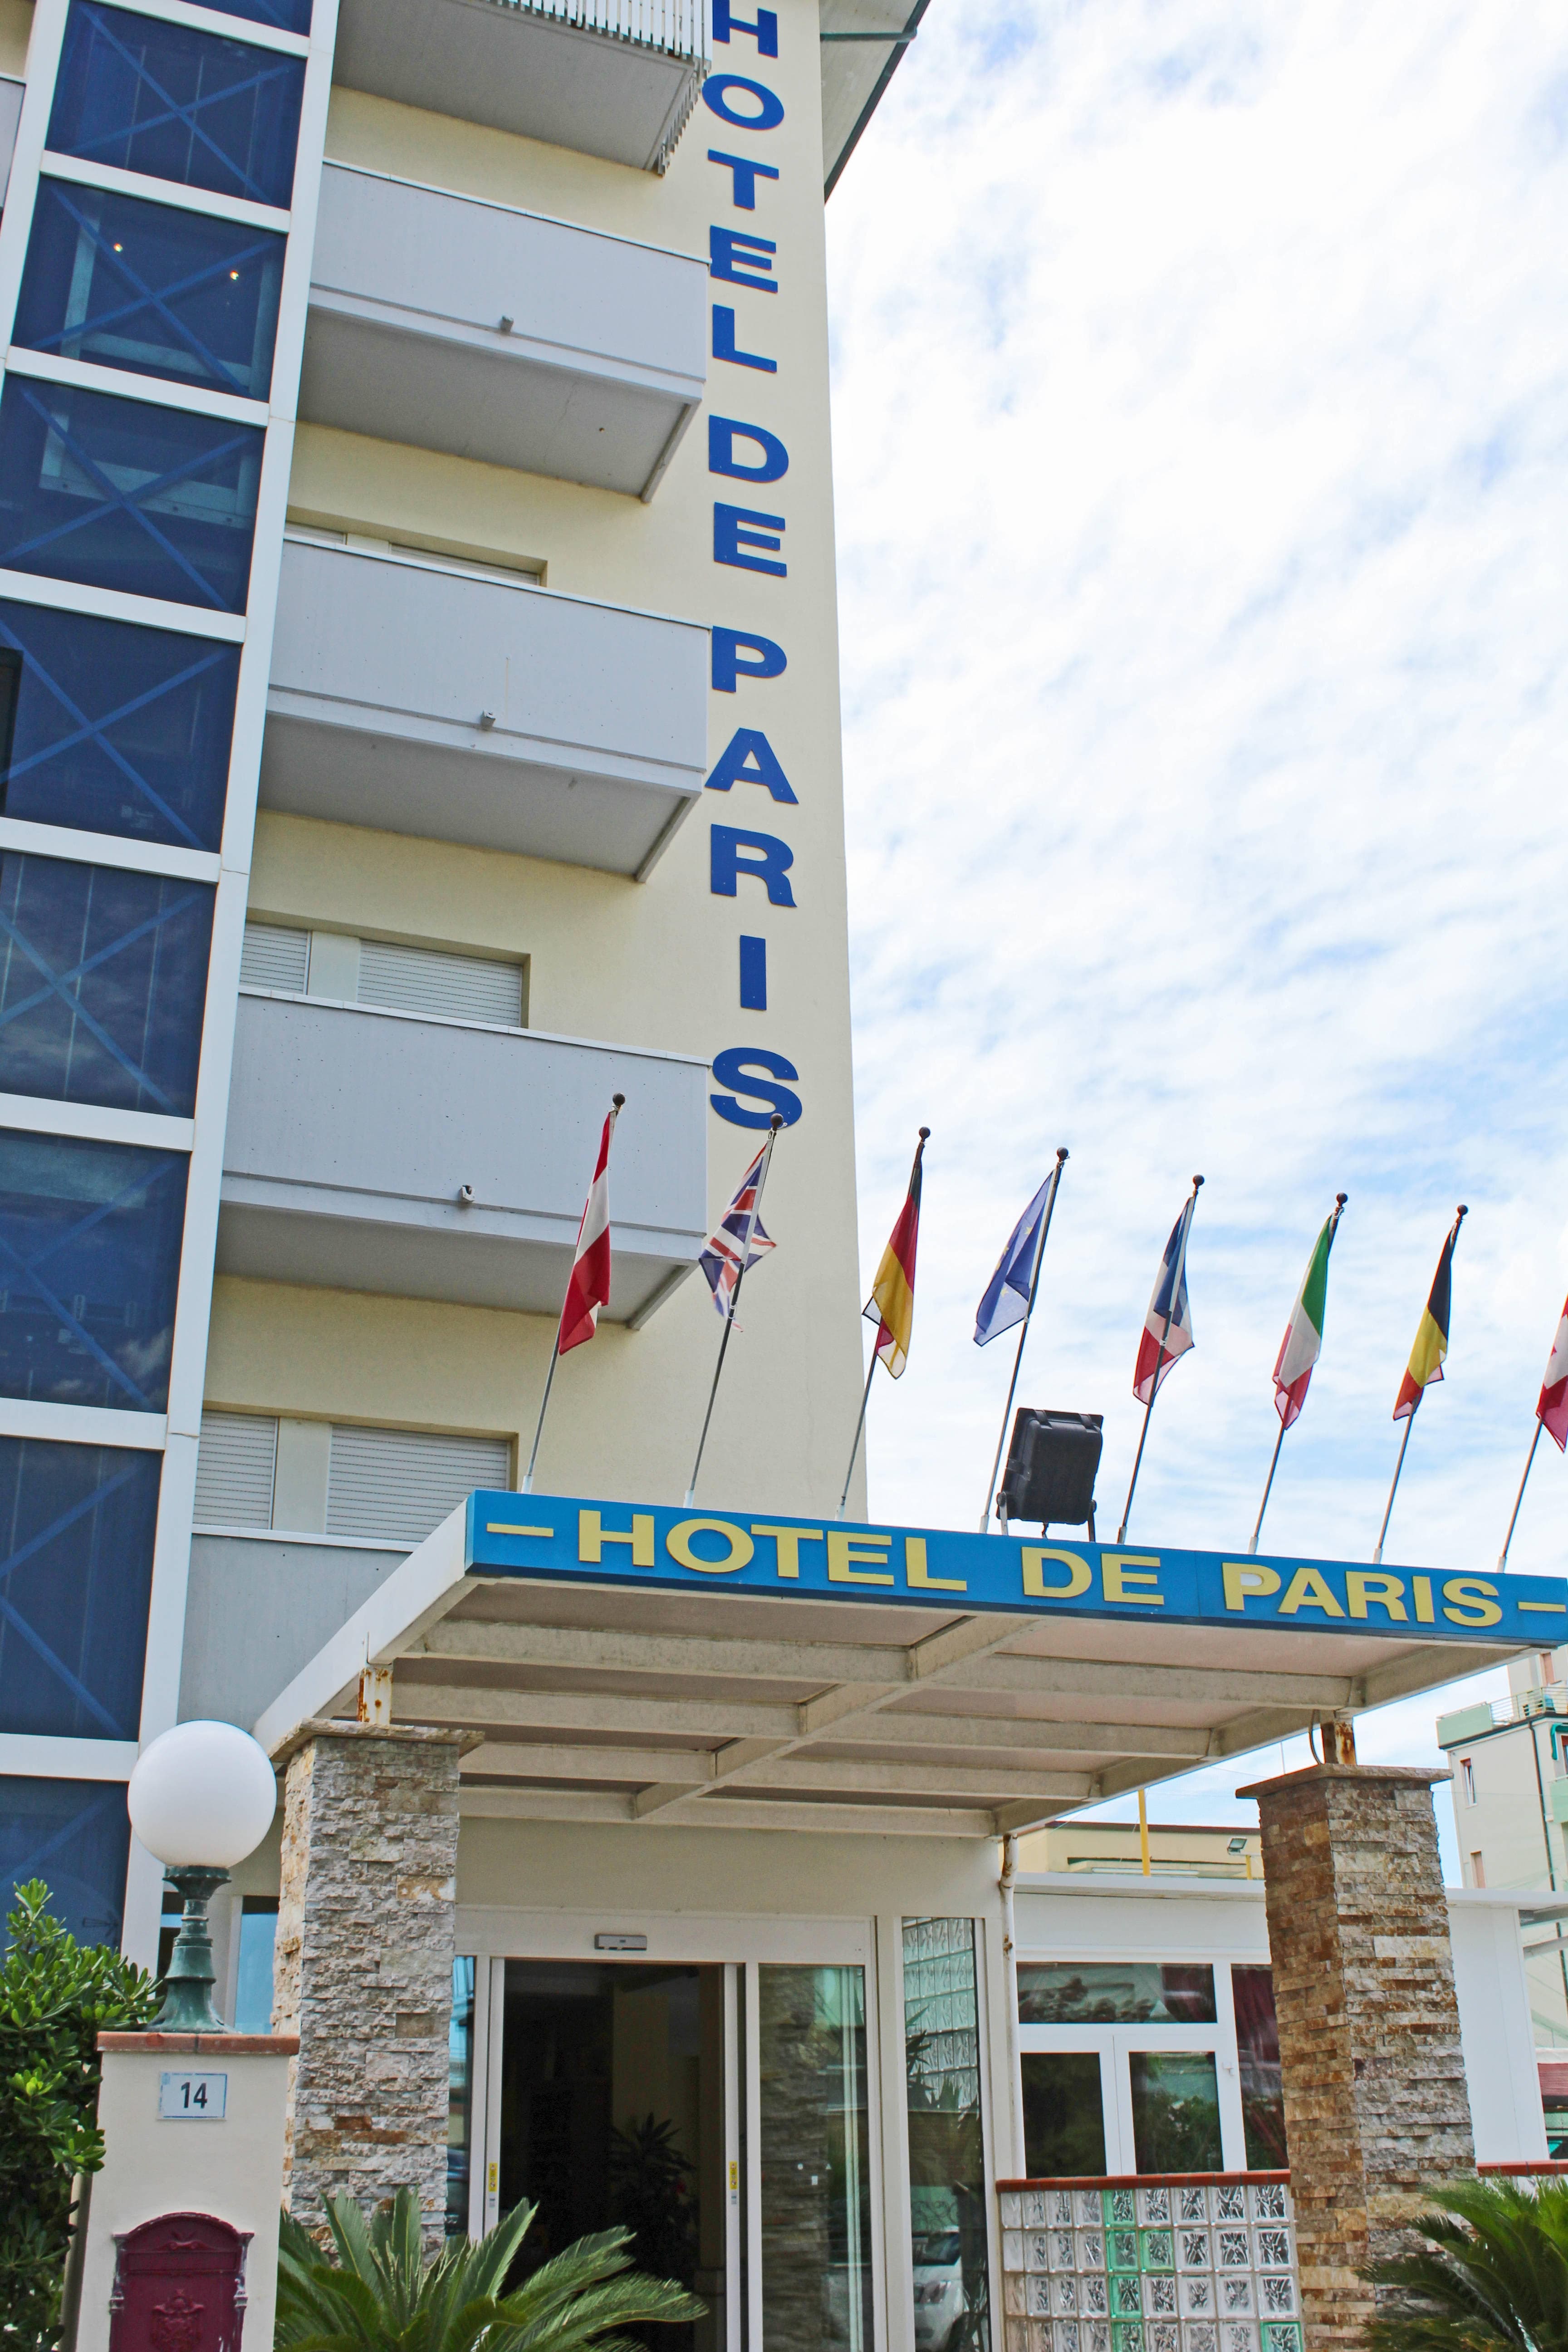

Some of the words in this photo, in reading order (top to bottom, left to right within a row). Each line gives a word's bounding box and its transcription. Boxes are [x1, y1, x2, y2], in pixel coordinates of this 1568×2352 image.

[701, 0, 785, 373] HOTEL
[709, 415, 789, 577] DE
[705, 626, 803, 1130] PARIS
[578, 1509, 967, 1591] HOTEL
[1021, 1546, 1164, 1605] DE
[1222, 1563, 1503, 1627] PARIS
[181, 2082, 208, 2109] 14
